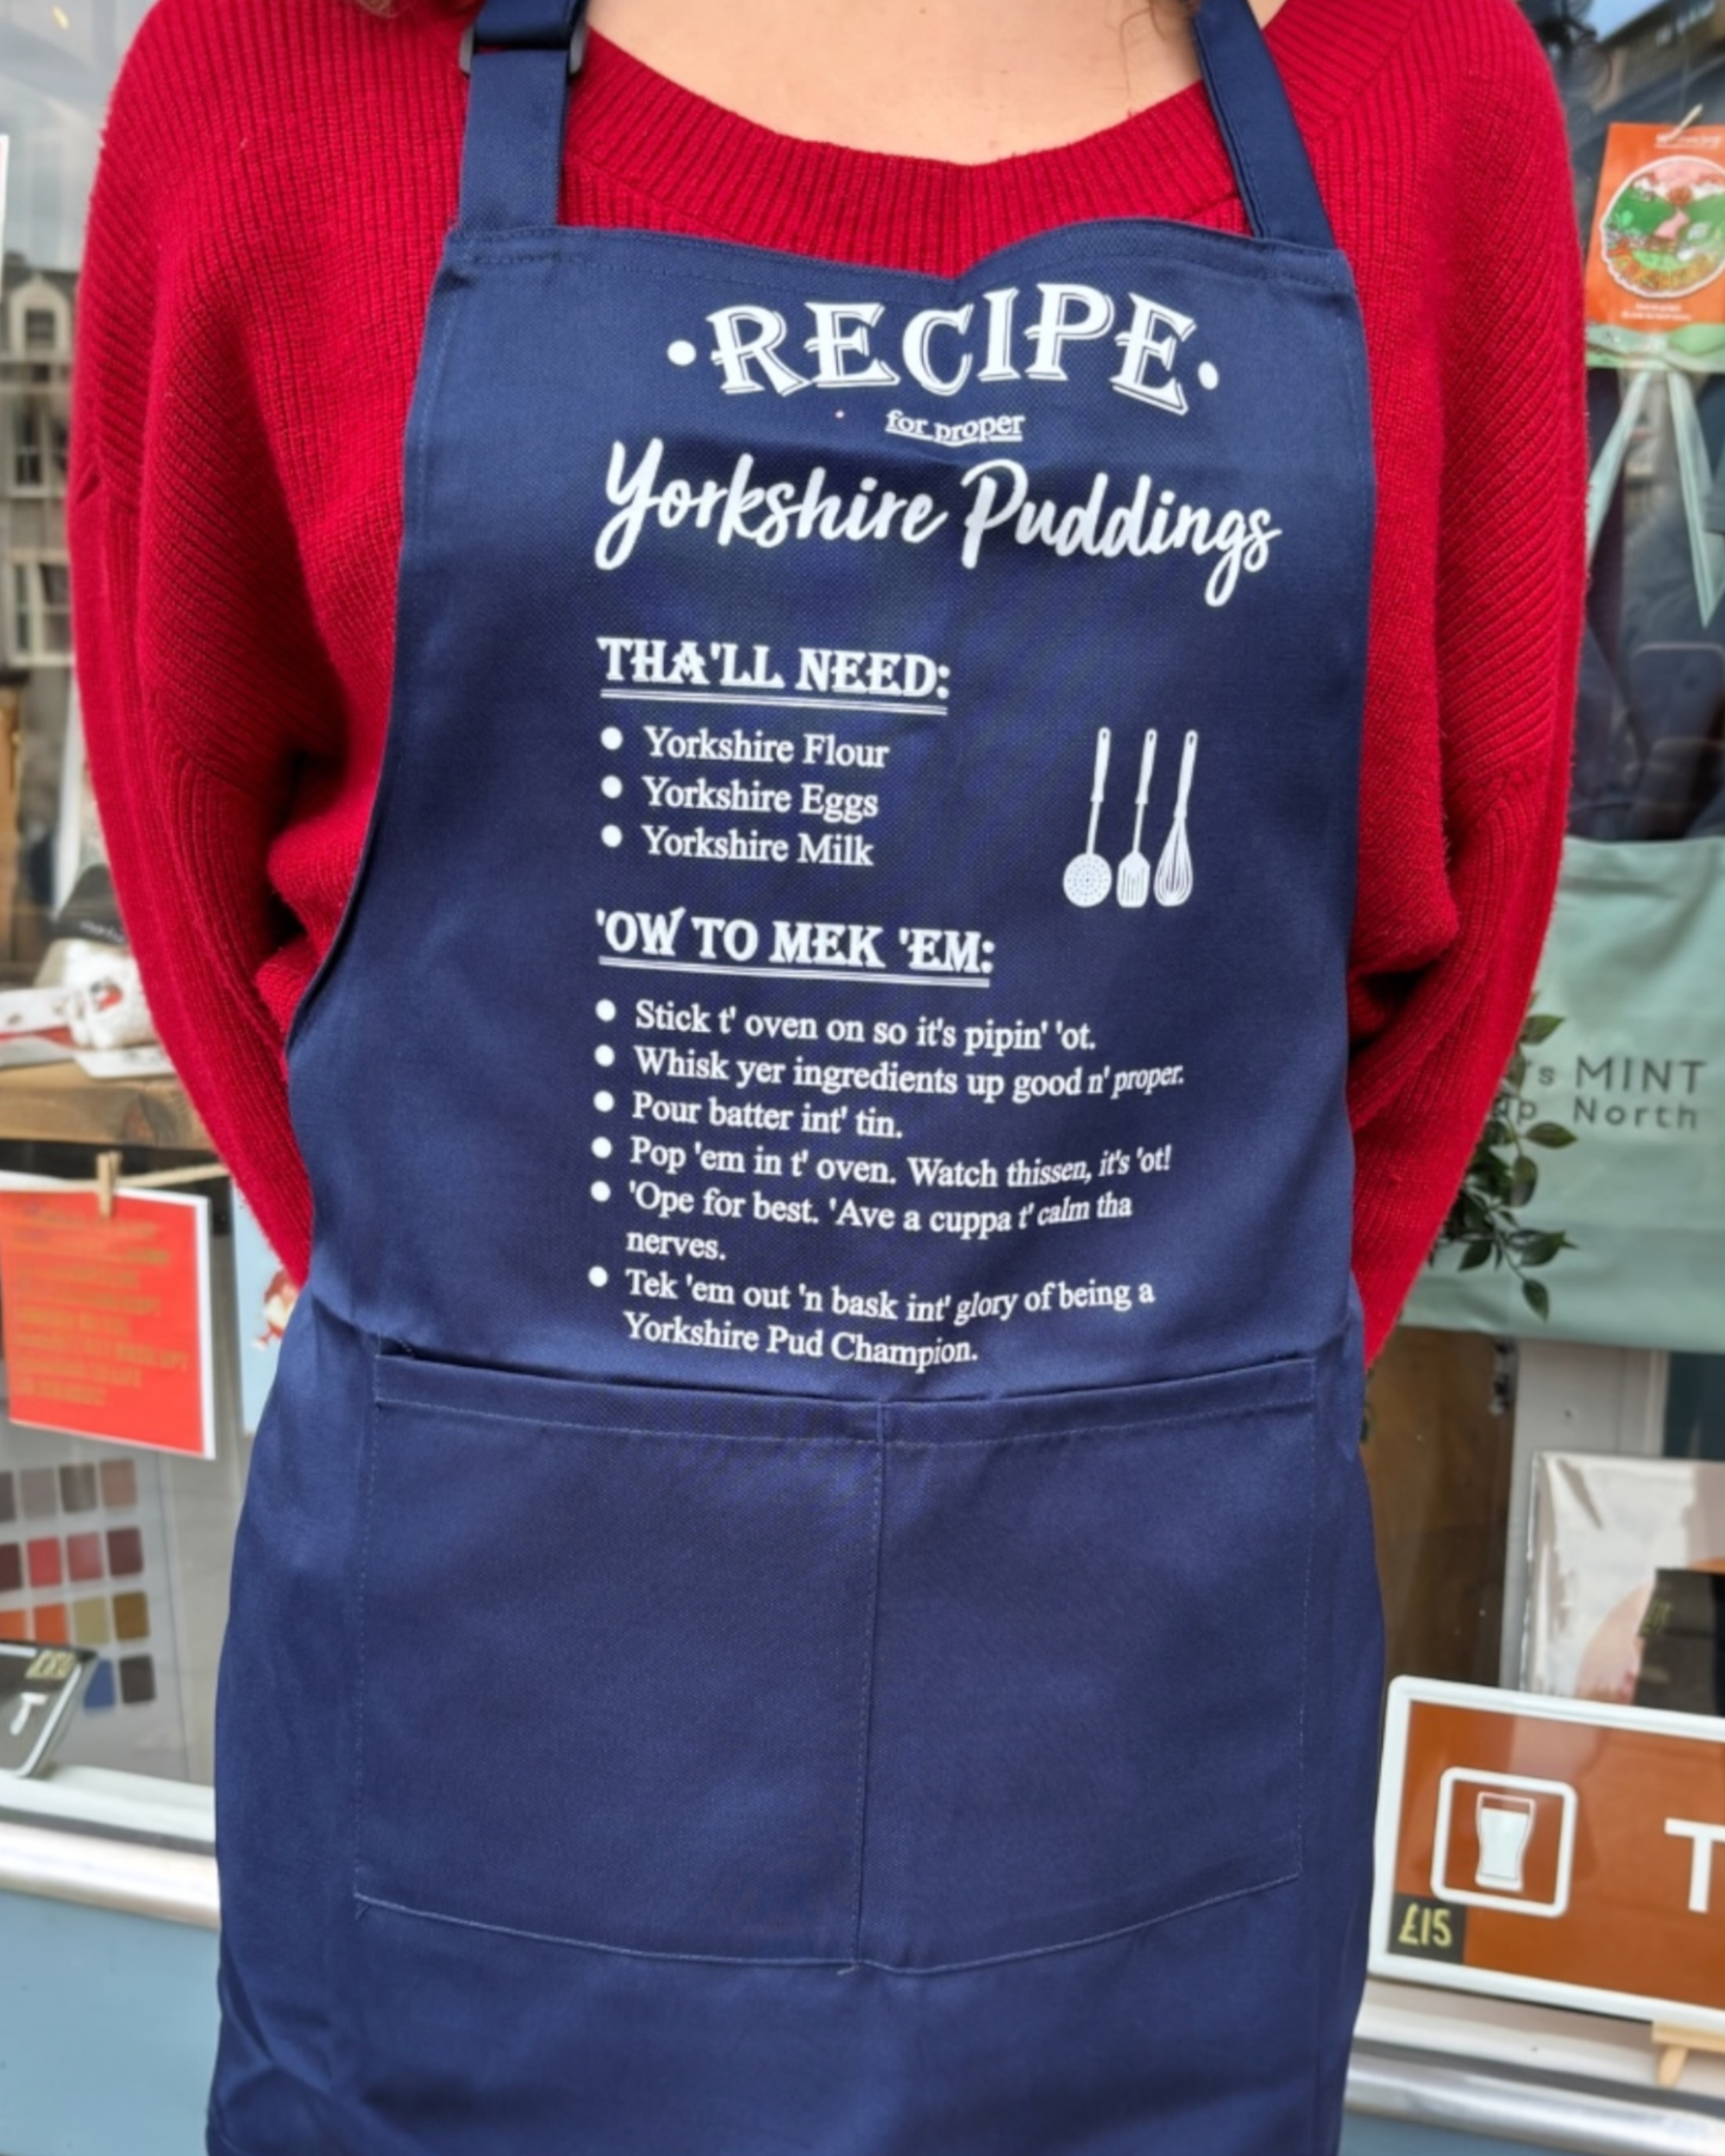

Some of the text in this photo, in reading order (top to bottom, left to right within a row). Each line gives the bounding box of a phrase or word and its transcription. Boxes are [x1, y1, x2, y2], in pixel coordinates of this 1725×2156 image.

[705, 282, 1198, 417] RECIPE
[885, 409, 1026, 444] for proper
[594, 437, 1283, 607] Yorkshire Puddings
[596, 636, 950, 699] THA'LL NEED:
[642, 724, 891, 768] Yorkshire Flour
[641, 775, 879, 825] Yorkshire Eggs
[641, 824, 875, 867] Yorkshire Milk
[595, 907, 995, 975] 'OW TO MEK 'EM:
[636, 999, 1096, 1057] Stick t' oven on so it's pipin' 'ot.
[633, 1044, 1184, 1105] Whisk yer ingredients up good n' proper.
[1576, 1055, 1706, 1094] MINT
[631, 1090, 903, 1139] Pour batter int' tin.
[1572, 1096, 1697, 1129] North
[630, 1135, 1172, 1188] Pop 'em in t' oven. Watch thissen, it's 'ot!
[629, 1180, 1132, 1240] 'Ope for best. 'Ave a cuppa t' calm tha
[626, 1232, 726, 1261] nerves.
[624, 1268, 1157, 1326] Tek 'em out 'n bask int' glory of being a
[623, 1310, 978, 1375] Yorkshire Pud Champion.
[1397, 1902, 1453, 1947] £15
